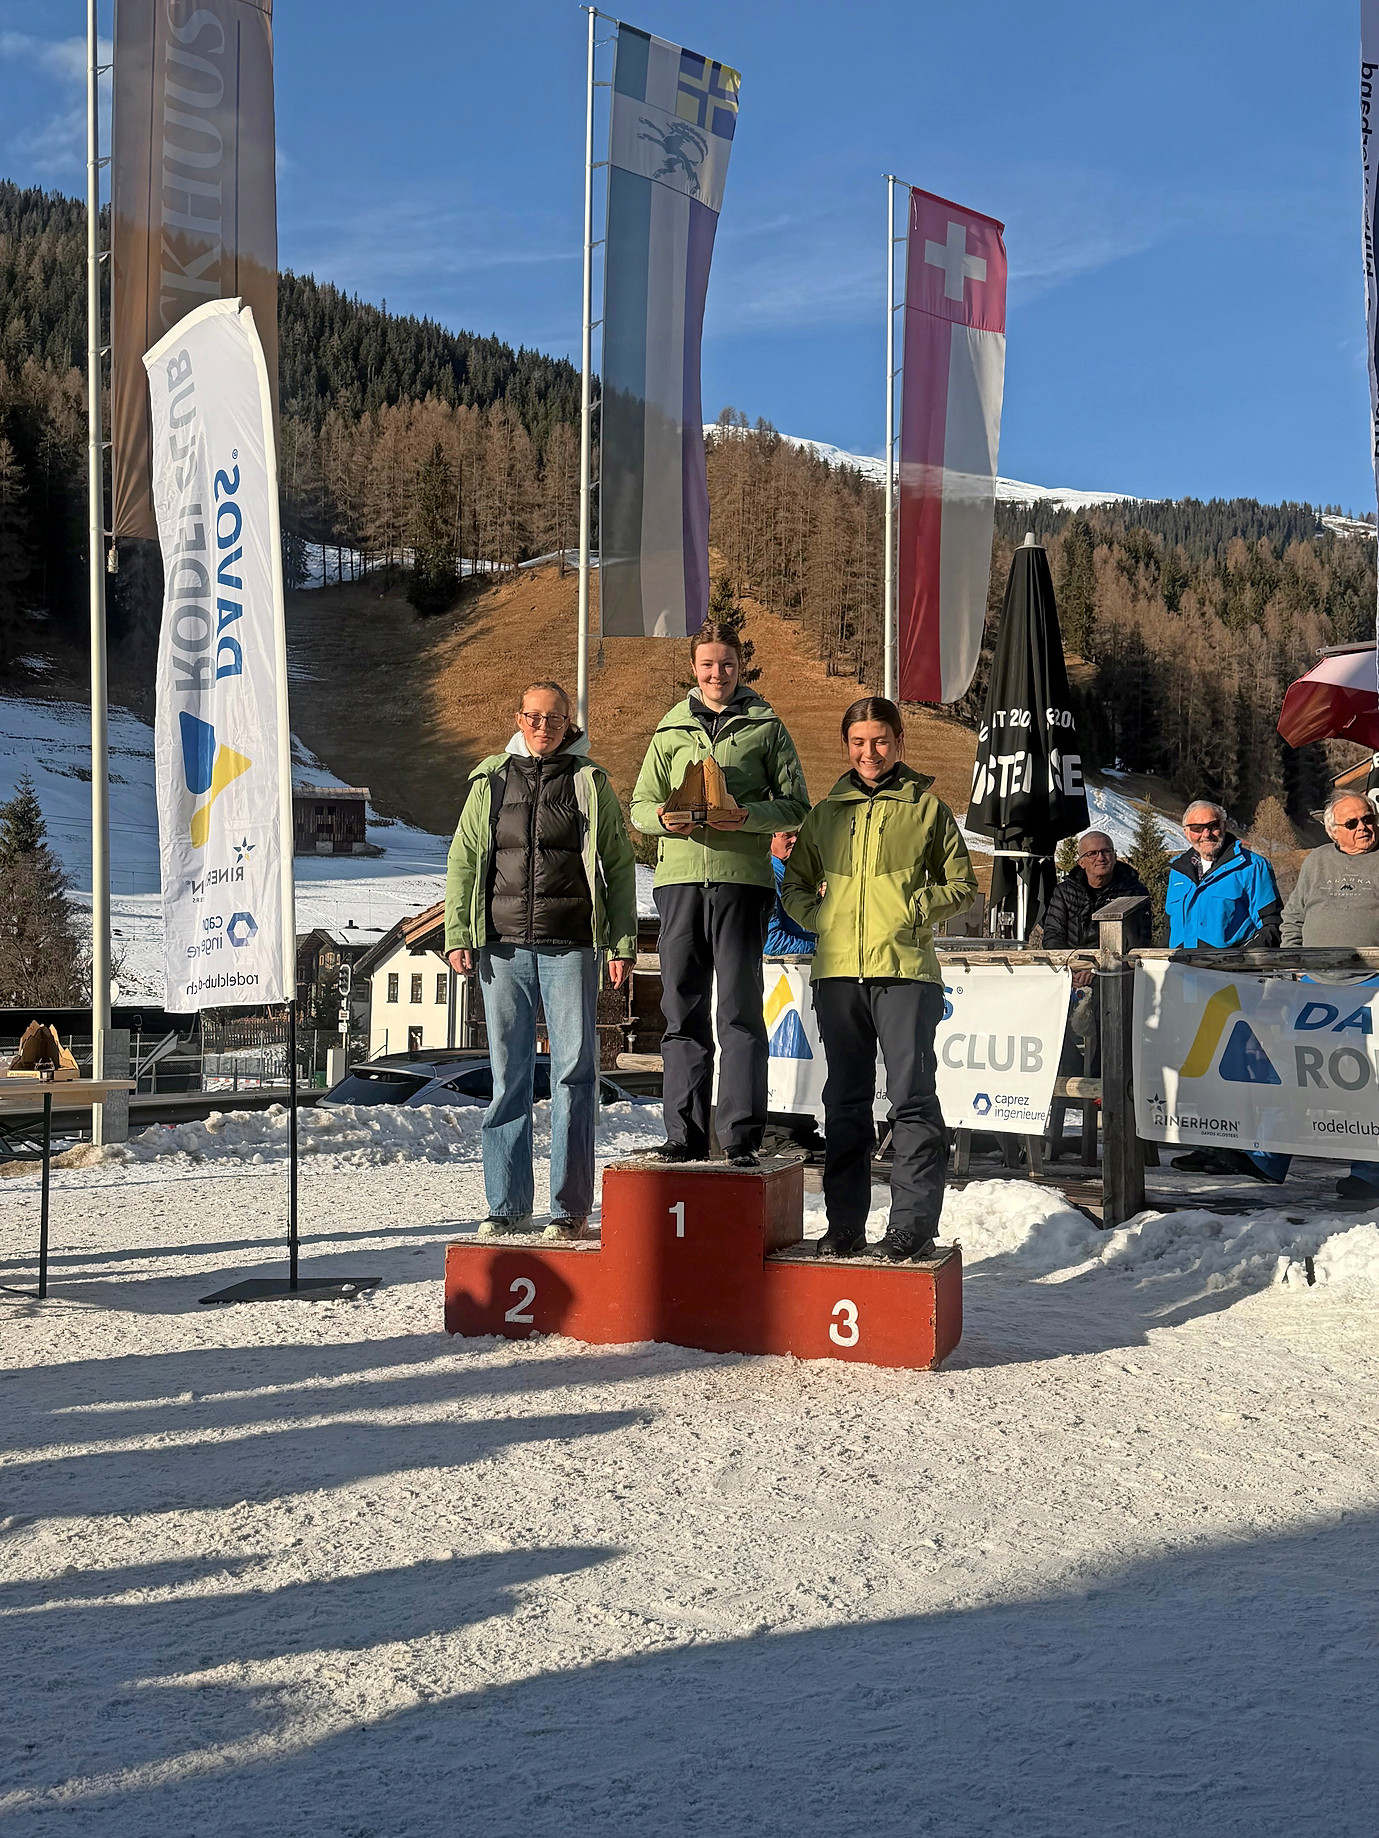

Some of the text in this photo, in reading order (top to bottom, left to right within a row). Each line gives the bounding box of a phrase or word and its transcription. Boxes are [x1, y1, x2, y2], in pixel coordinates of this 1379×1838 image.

[941, 1033, 1044, 1073] CLUB
[1294, 1045, 1379, 1092] RO
[994, 1094, 1030, 1107] caprez
[994, 1105, 1046, 1121] ingenieure
[668, 1201, 685, 1238] 1
[504, 1277, 537, 1324] 2
[828, 1298, 860, 1347] 3
